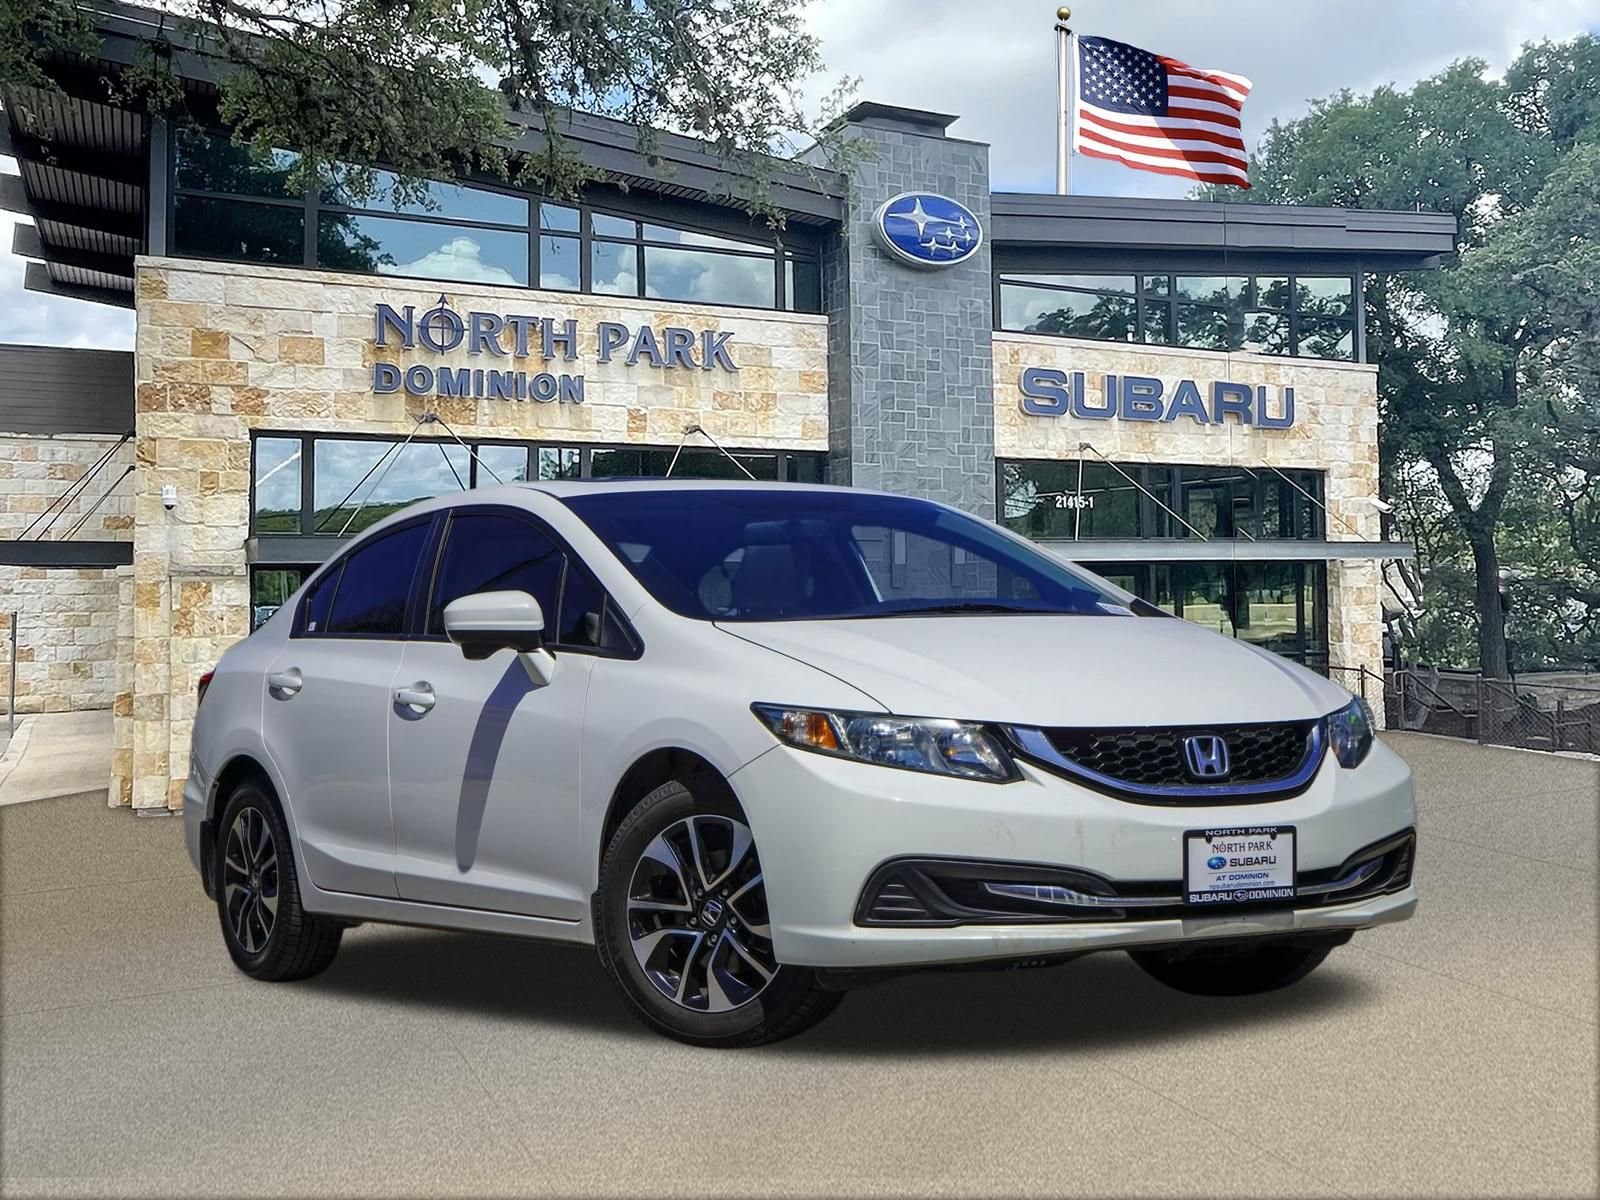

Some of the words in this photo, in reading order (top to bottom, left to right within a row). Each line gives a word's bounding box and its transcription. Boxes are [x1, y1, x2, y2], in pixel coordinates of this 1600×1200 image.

[374, 292, 579, 362] NORTH
[598, 321, 740, 373] PARK
[374, 362, 584, 404] DOMINION
[1019, 367, 1295, 430] SUBARU
[1212, 841, 1246, 853] NORTH
[1247, 840, 1273, 851] PARK
[1230, 856, 1276, 867] SUBARU
[1228, 872, 1269, 881] DOMINION
[1189, 892, 1233, 903] SUBARU
[1249, 889, 1294, 899] DOMINION
